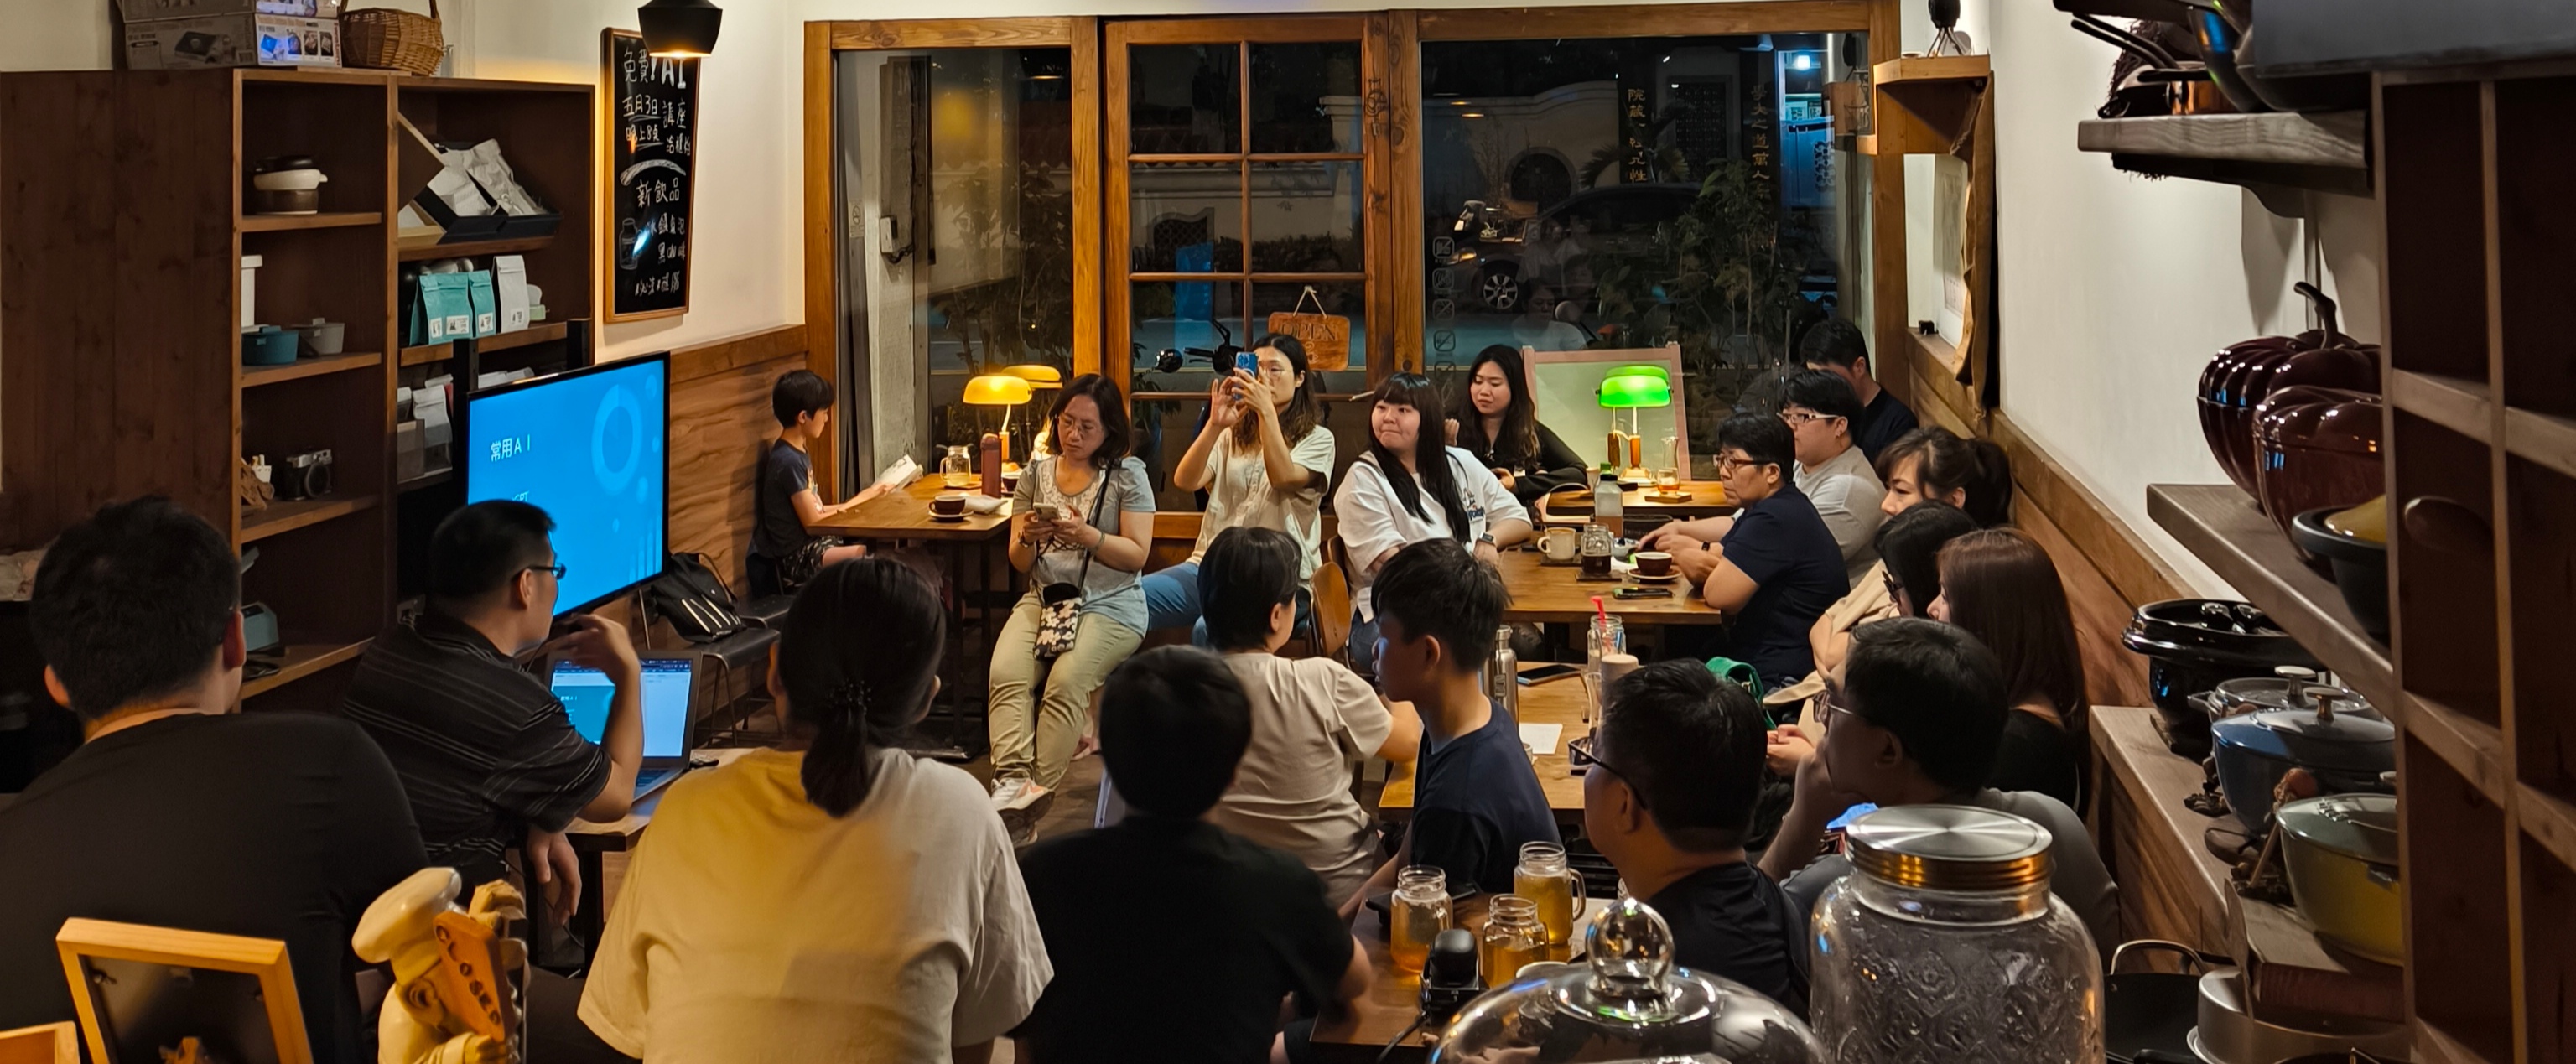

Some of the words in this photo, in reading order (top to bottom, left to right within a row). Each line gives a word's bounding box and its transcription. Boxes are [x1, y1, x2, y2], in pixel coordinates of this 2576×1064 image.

[622, 94, 658, 117] 五月3日
[662, 99, 687, 128] 講座
[635, 176, 680, 209] 新飲品
[1280, 321, 1339, 342] OPEN
